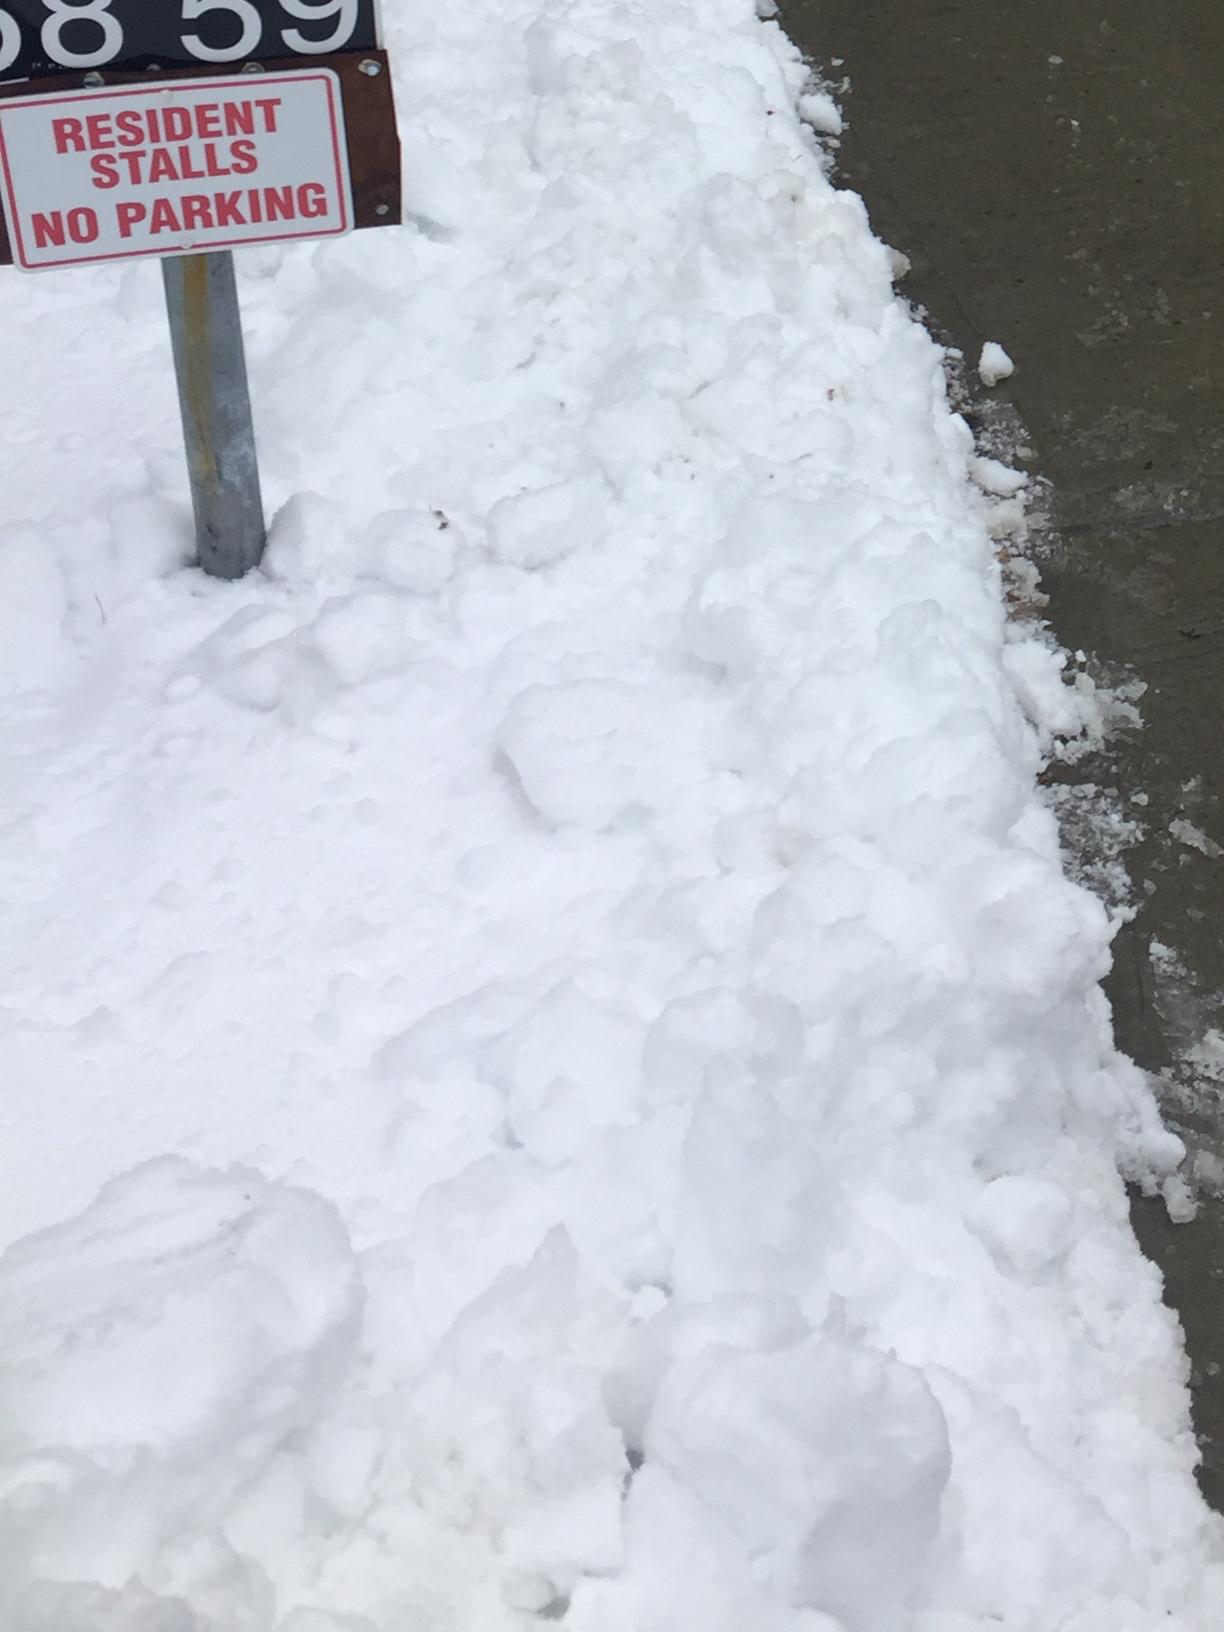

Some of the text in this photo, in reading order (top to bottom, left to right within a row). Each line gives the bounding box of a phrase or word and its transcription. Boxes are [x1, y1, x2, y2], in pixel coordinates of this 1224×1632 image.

[52, 97, 282, 154] RESIDENT
[90, 139, 259, 189] STALLS
[31, 182, 328, 248] NO PARKING
